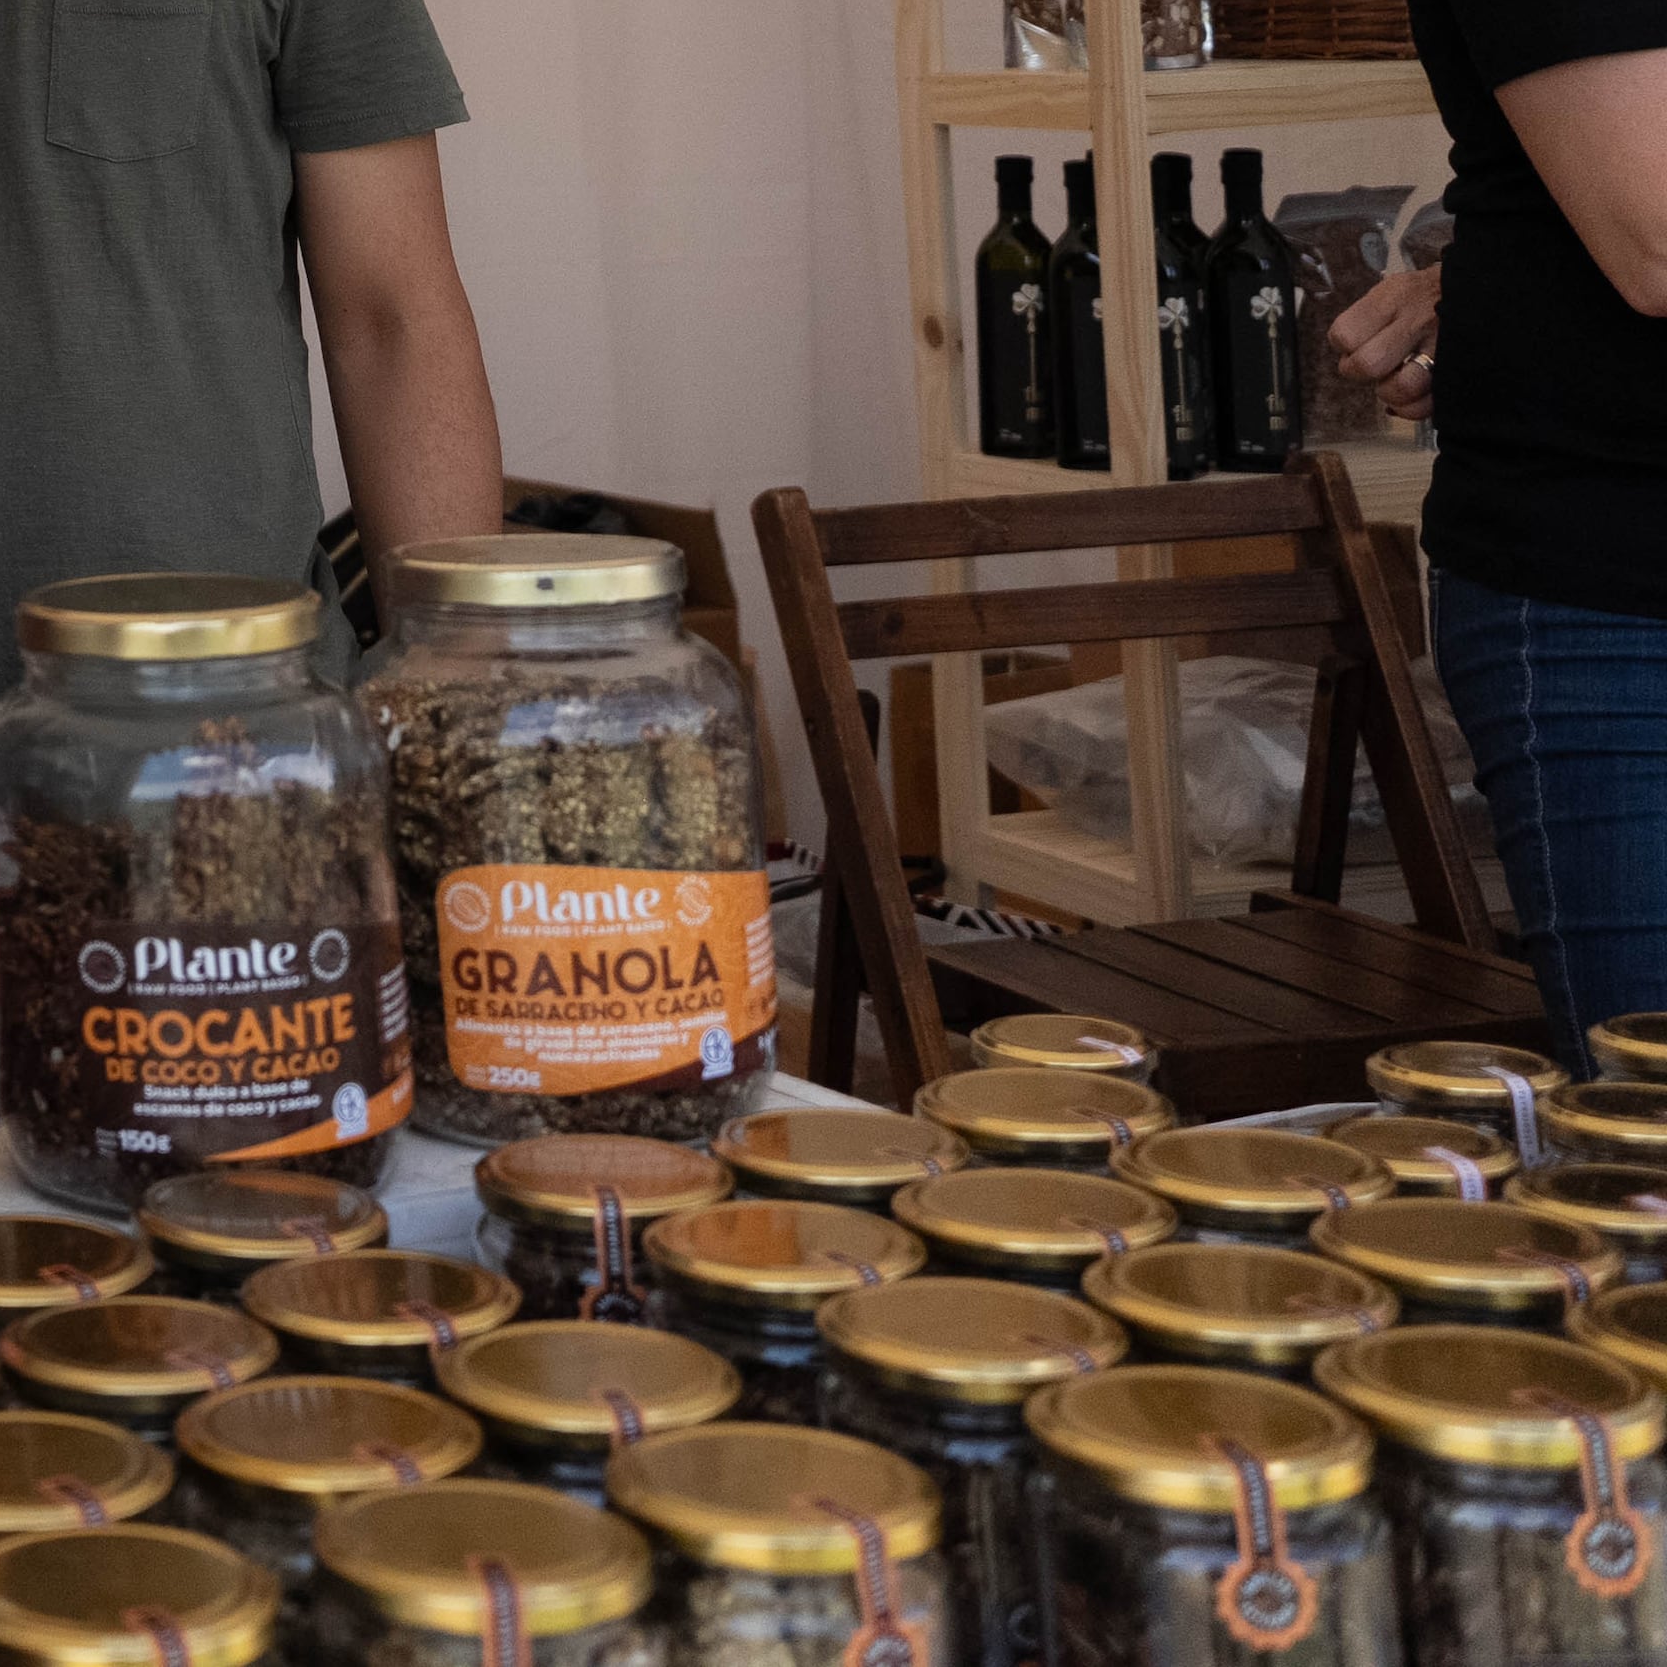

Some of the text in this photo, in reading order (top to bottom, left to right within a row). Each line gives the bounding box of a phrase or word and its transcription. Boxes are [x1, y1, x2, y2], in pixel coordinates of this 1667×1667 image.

[501, 879, 661, 924] Plante
[134, 936, 298, 983] Plante
[452, 940, 722, 997] GRANOLA
[455, 989, 726, 1021] DE SARRACENO Y CACAO
[81, 993, 357, 1058] CROCANTE
[105, 1047, 341, 1084] DE COCO Y CACAO
[489, 1064, 542, 1088] 250g
[144, 1084, 191, 1101] Snack
[193, 1083, 238, 1100] dulce
[227, 1101, 265, 1117] coco
[118, 1128, 172, 1155] 150g
